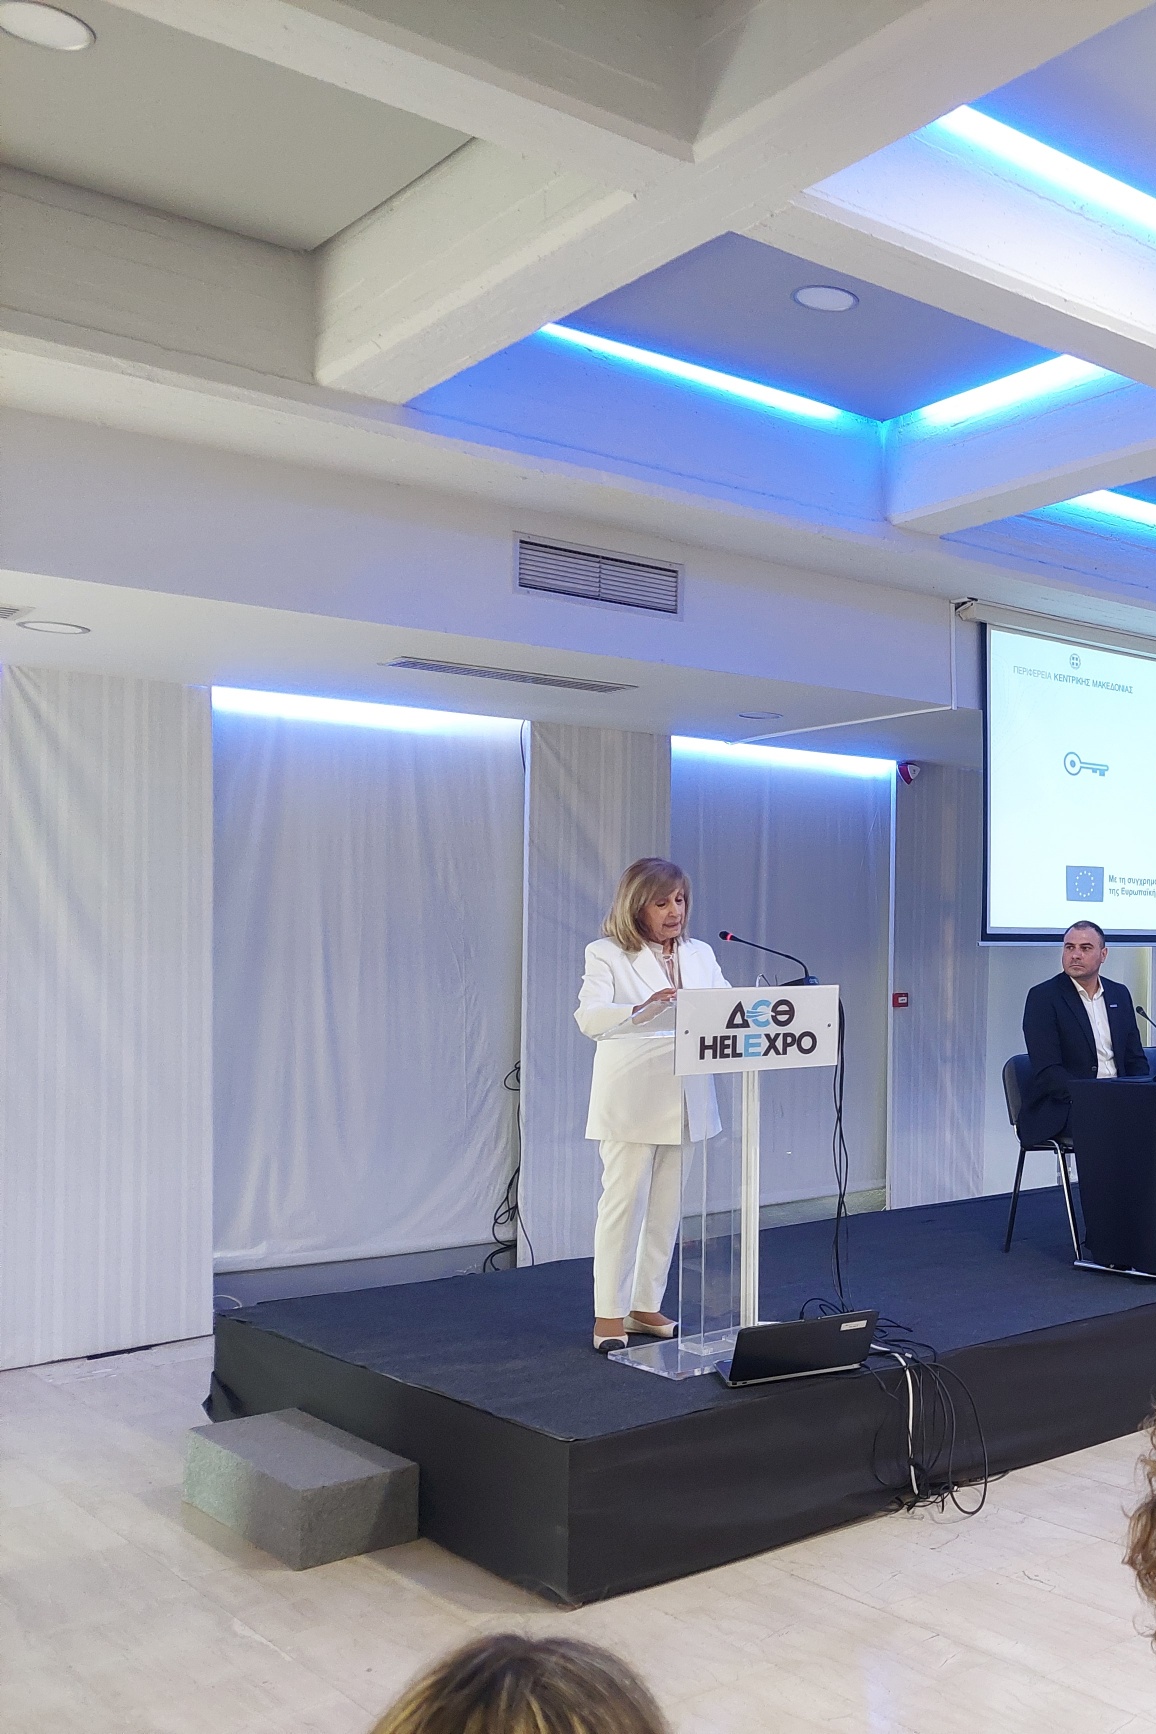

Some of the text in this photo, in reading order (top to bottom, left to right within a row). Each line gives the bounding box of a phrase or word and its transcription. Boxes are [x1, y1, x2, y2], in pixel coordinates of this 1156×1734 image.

[1013, 665, 1133, 694] ΠΕΡΙΦΕΡΕΙΑ ΚΕΝΤΡΙΚΗΣ ΜΑΚΕΔΟΝΙΑΣ
[1109, 874, 1117, 883] Με
[1119, 877, 1126, 885] τη
[1109, 888, 1119, 896] της
[699, 1031, 817, 1060] HELEXPO
